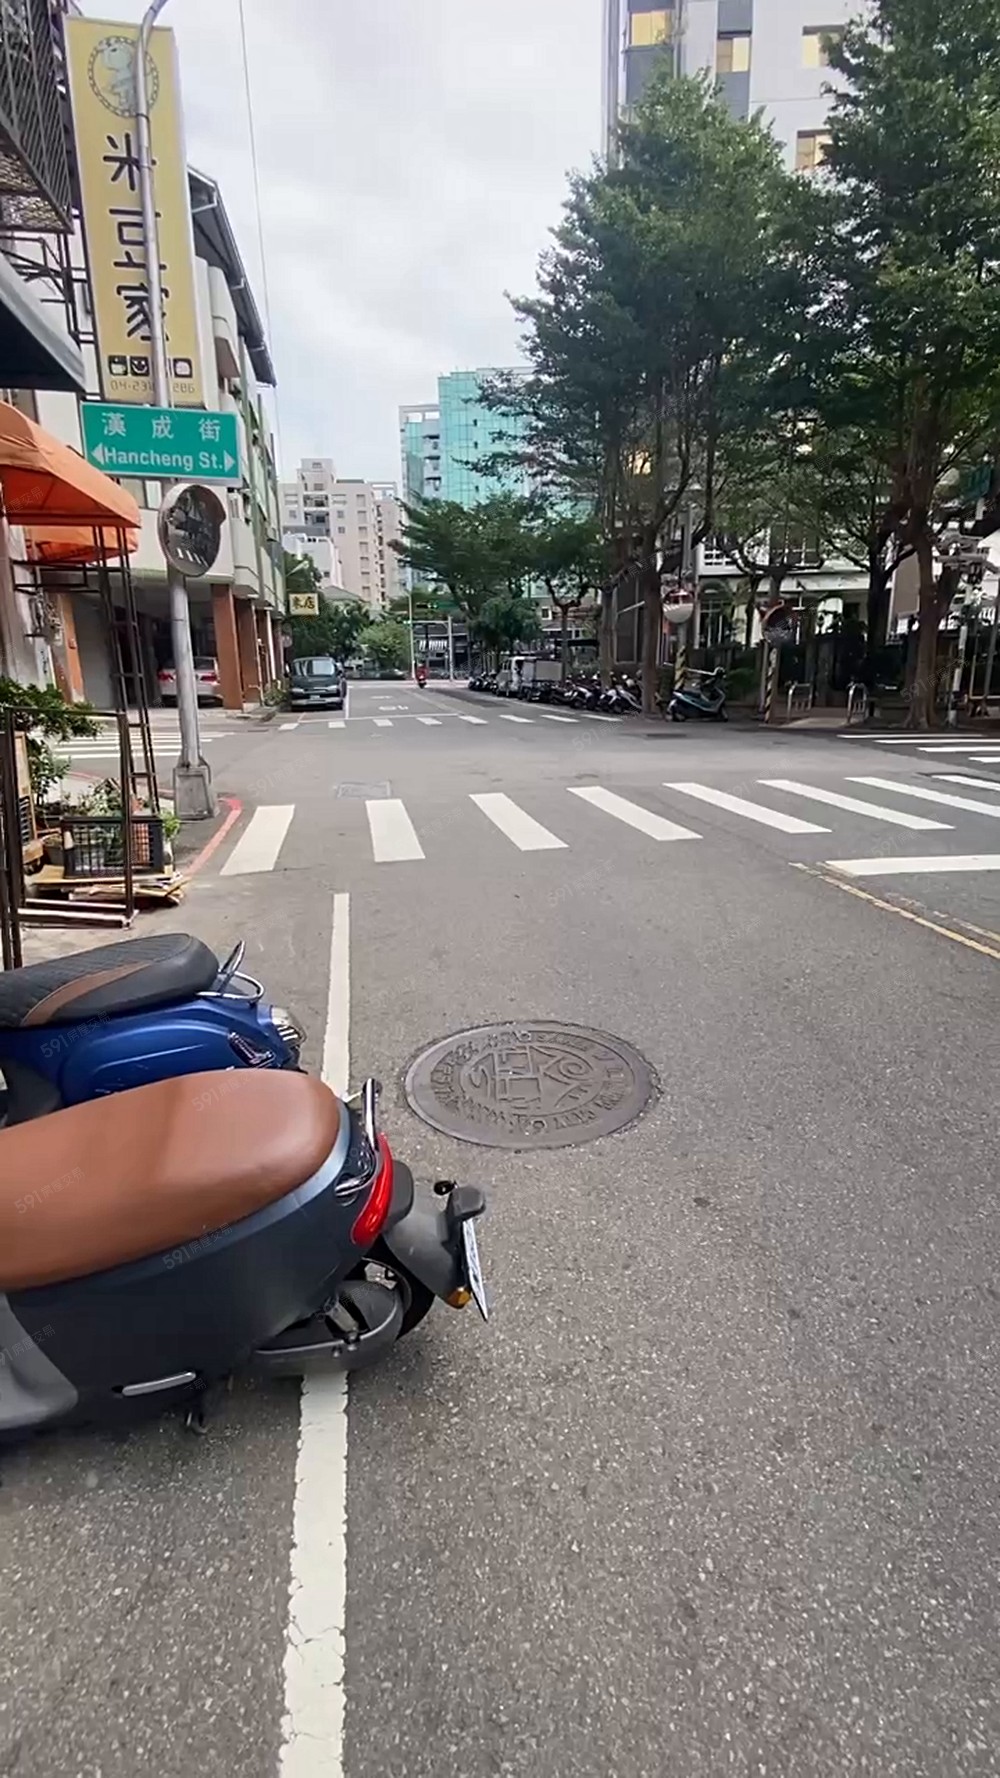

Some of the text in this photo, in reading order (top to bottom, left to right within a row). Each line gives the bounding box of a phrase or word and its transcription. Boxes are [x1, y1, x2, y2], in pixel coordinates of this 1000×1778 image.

[101, 411, 222, 443] 漢成街
[104, 446, 224, 471] Hancheng St.
